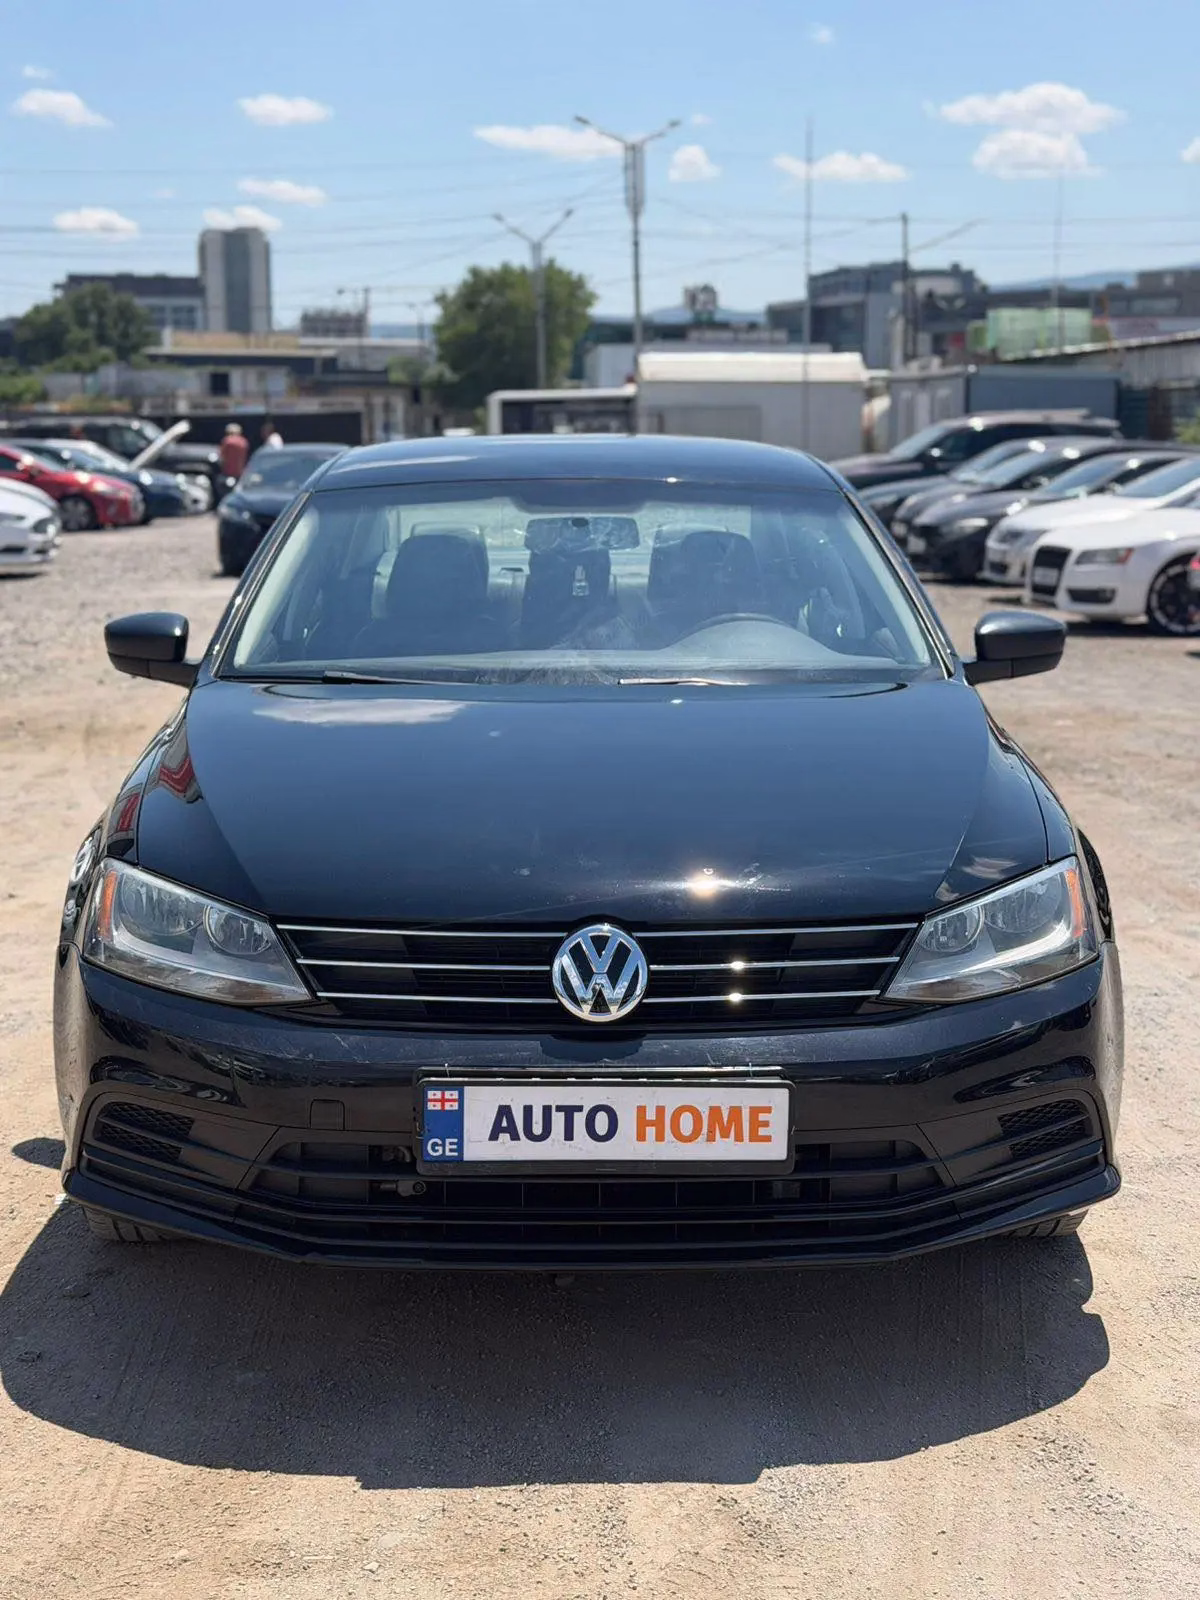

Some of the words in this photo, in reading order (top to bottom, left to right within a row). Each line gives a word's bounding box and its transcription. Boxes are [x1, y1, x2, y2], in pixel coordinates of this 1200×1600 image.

[554, 926, 646, 1019] VW
[488, 1104, 618, 1142] AUTO
[635, 1105, 773, 1143] HOME
[427, 1138, 458, 1157] GE
